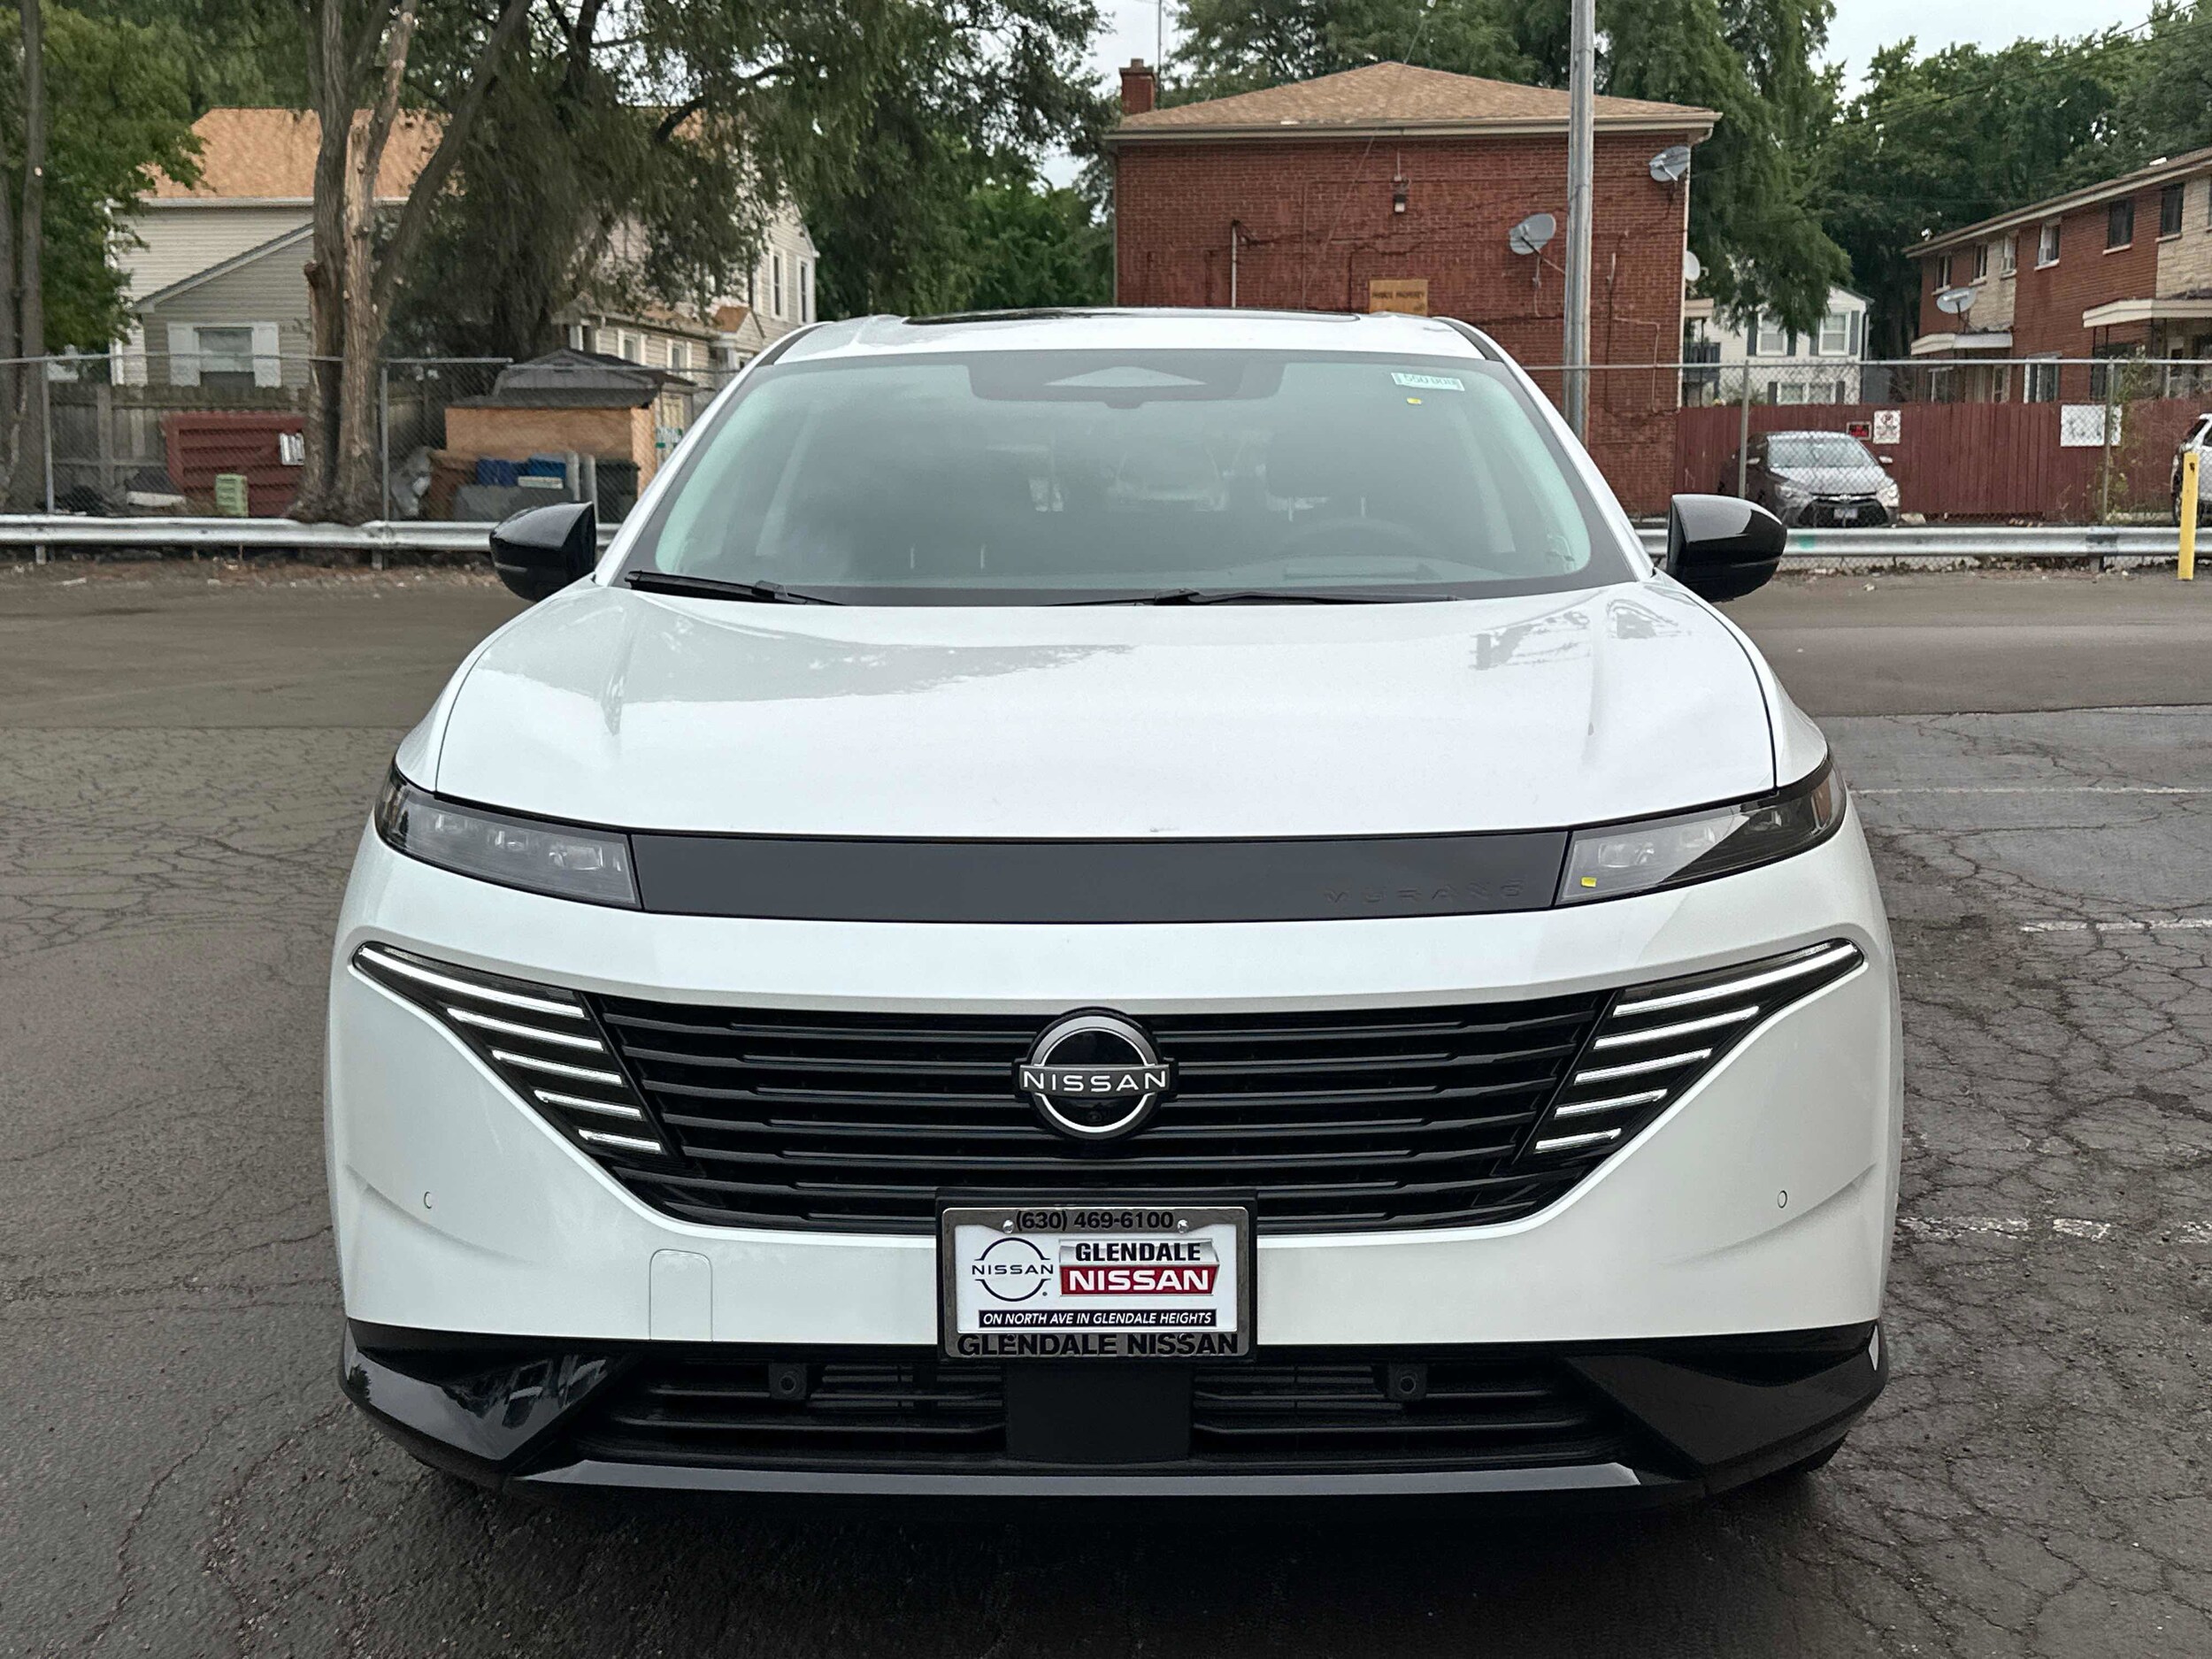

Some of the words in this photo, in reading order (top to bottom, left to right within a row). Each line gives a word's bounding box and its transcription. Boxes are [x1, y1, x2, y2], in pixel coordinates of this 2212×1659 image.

[1325, 879, 1524, 903] MURANO
[1023, 1070, 1166, 1092] NISSAN
[1017, 1210, 1068, 1232] (630)
[1074, 1211, 1174, 1229] 469-6100
[1075, 1242, 1202, 1262] GLENDALE
[972, 1264, 1054, 1275] NISSAN
[1069, 1269, 1209, 1291] NISSAN
[983, 1313, 1002, 1325] ON
[1004, 1313, 1048, 1325] NORTH
[1049, 1313, 1074, 1325] AVE
[1076, 1313, 1090, 1325] IN
[1093, 1312, 1160, 1325] GLENDALE
[1159, 1312, 1212, 1325] HEIGHTS
[957, 1333, 1118, 1356] GLENDALE
[1127, 1333, 1238, 1356] NISSAN
